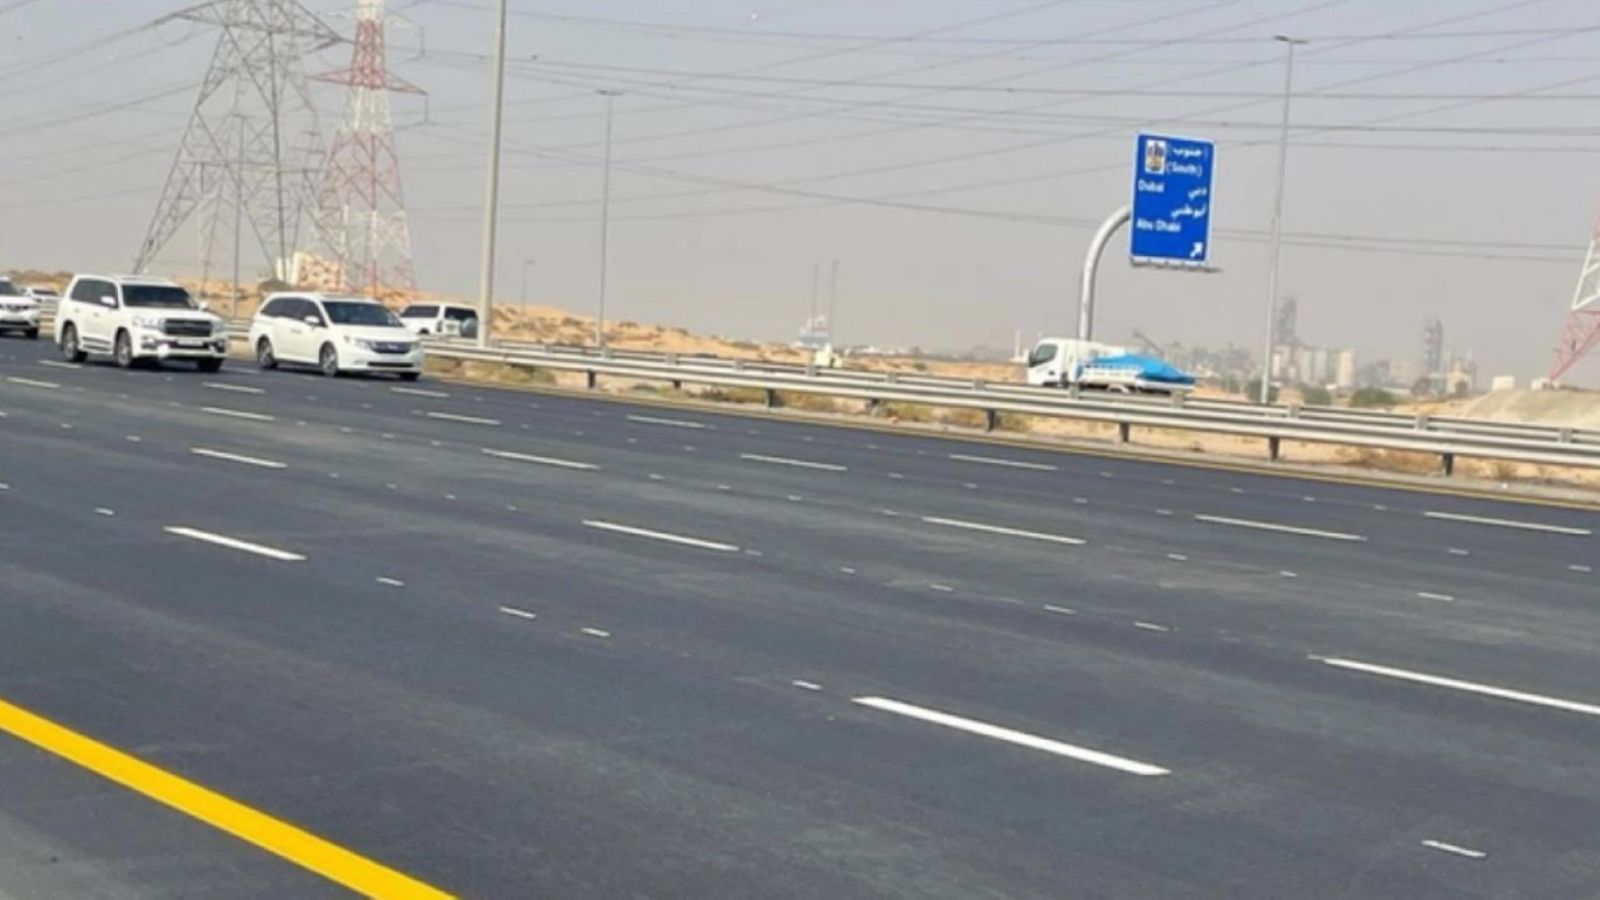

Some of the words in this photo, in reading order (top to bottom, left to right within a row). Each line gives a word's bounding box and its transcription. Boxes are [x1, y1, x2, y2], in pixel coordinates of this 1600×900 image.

[1138, 179, 1164, 193] Dubai
[1136, 218, 1153, 231] Abu
[1155, 219, 1181, 232] Dhabi
